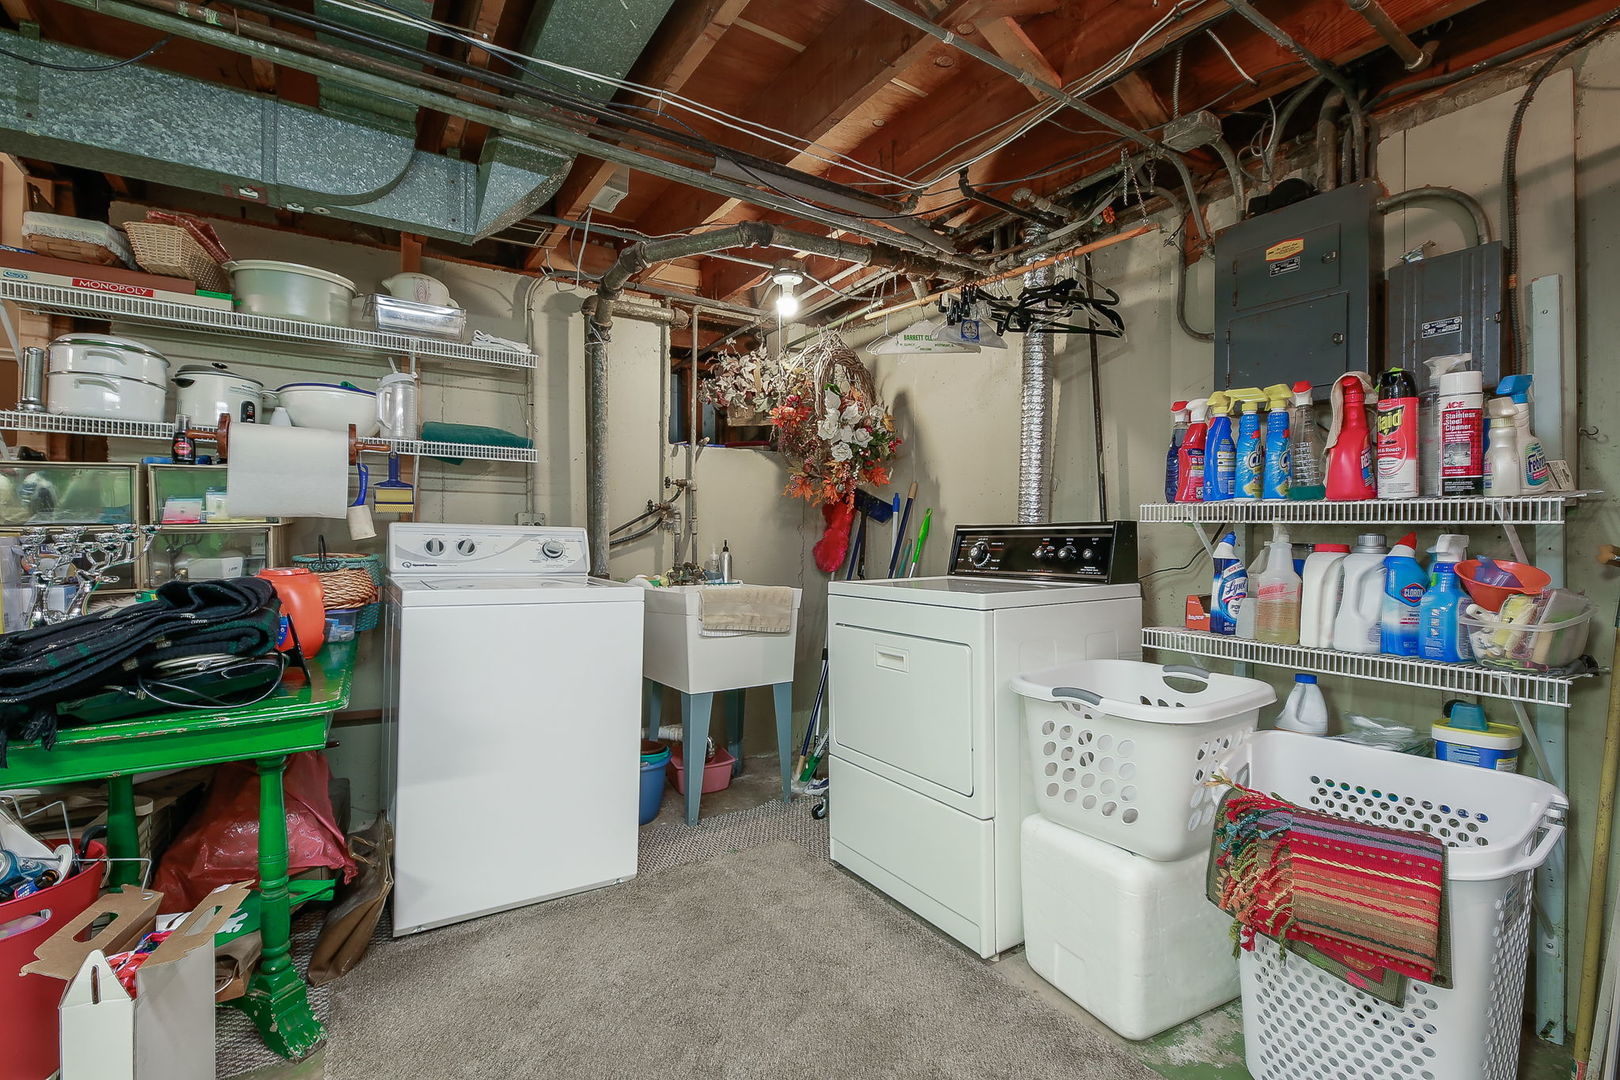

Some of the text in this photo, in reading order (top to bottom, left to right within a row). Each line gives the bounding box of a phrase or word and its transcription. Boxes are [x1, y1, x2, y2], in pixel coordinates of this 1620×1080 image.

[78, 280, 147, 295] MONOPOLY
[1445, 401, 1464, 409] ACE
[1226, 580, 1248, 594] Lysol
